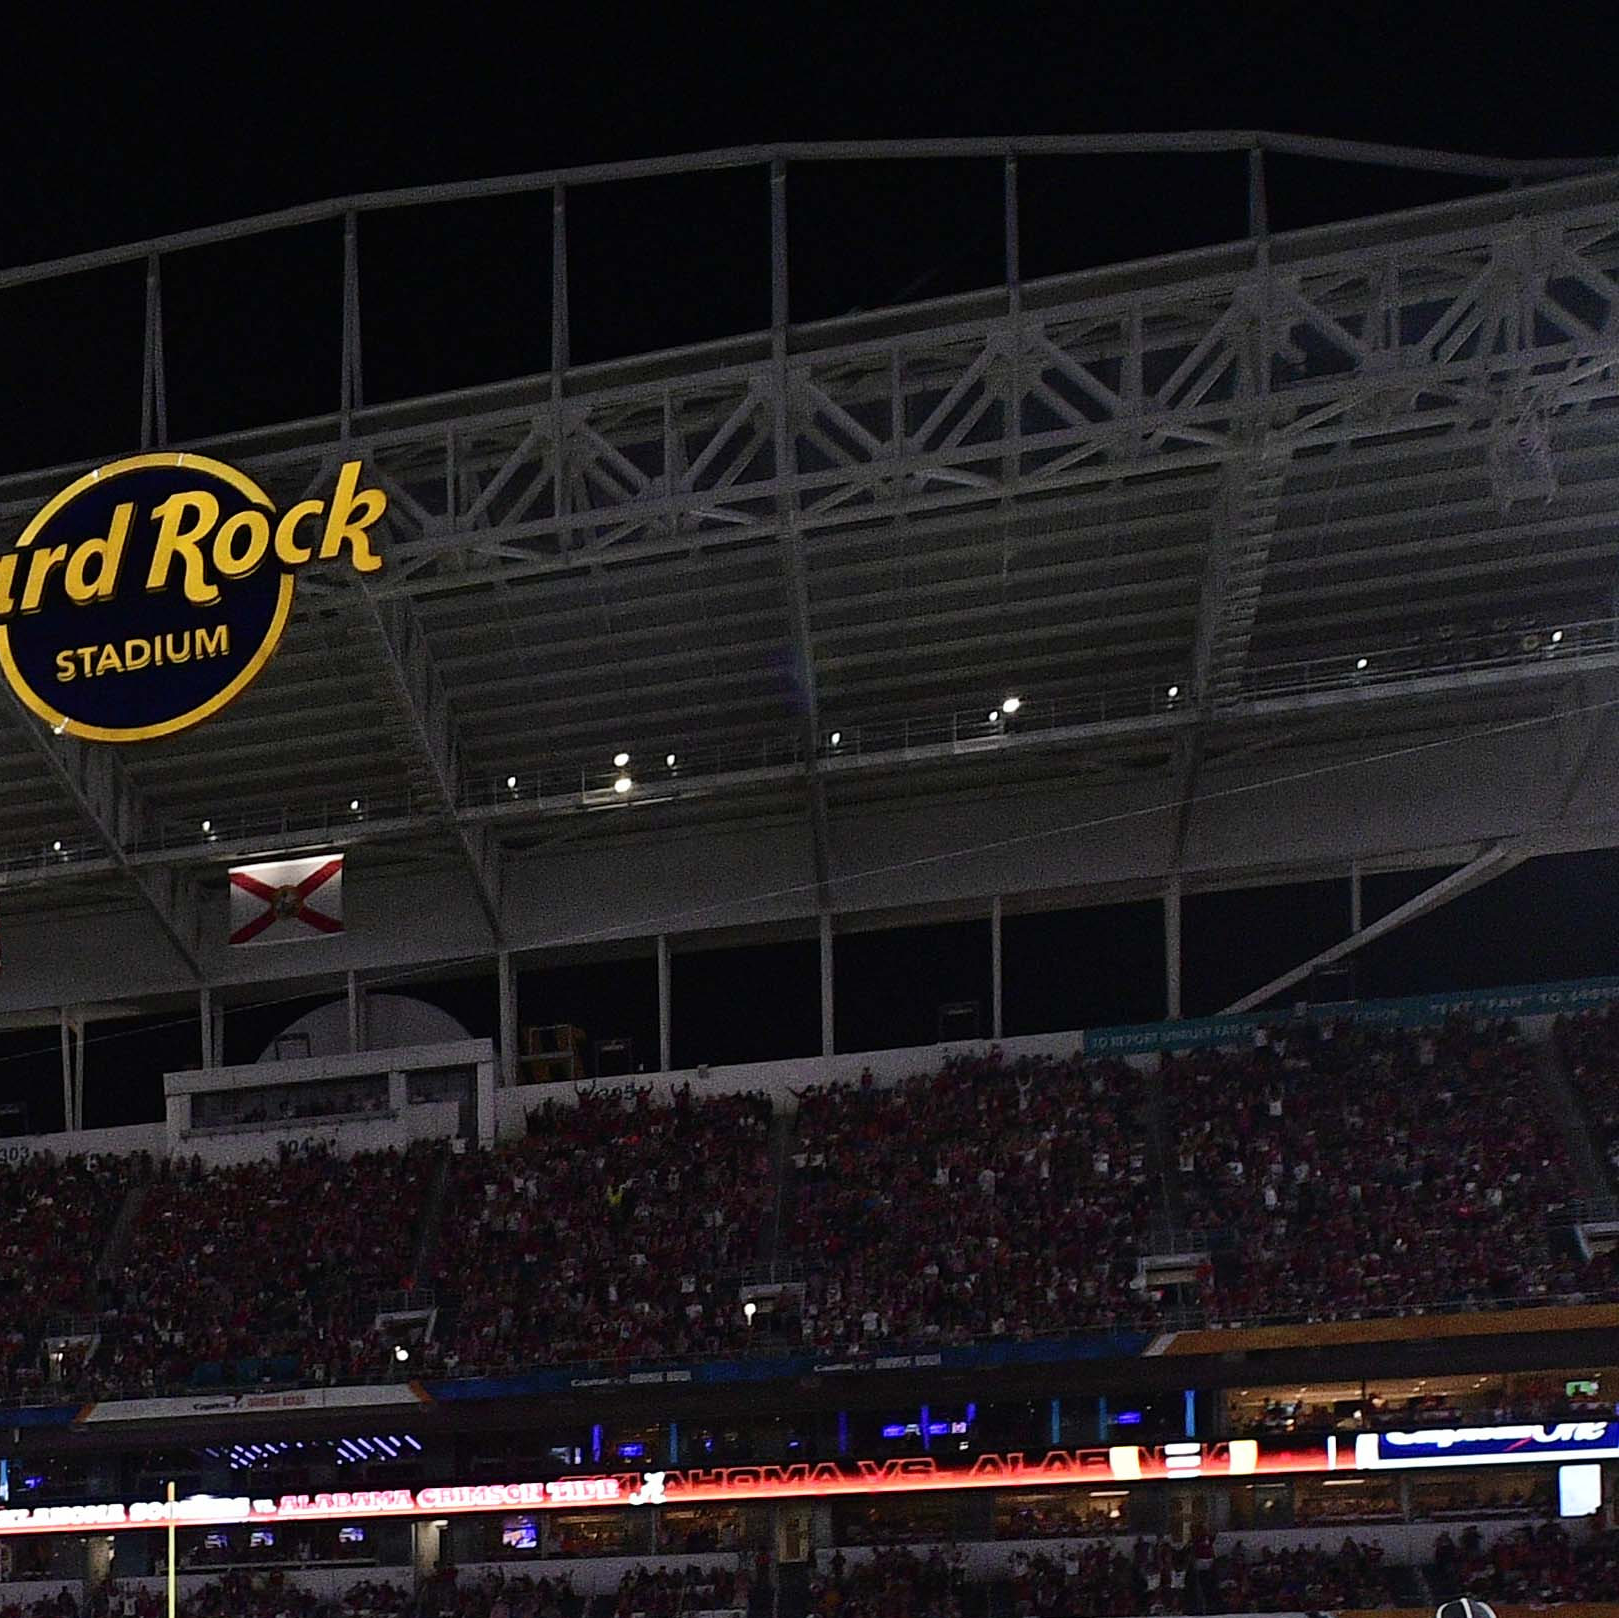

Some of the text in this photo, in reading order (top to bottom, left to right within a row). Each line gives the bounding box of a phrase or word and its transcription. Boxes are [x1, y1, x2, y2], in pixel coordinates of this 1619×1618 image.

[146, 461, 387, 603] Rock
[56, 624, 230, 682] STADIUM
[278, 1489, 415, 1516] ALABAMA
[416, 1481, 545, 1508] CRIMSON
